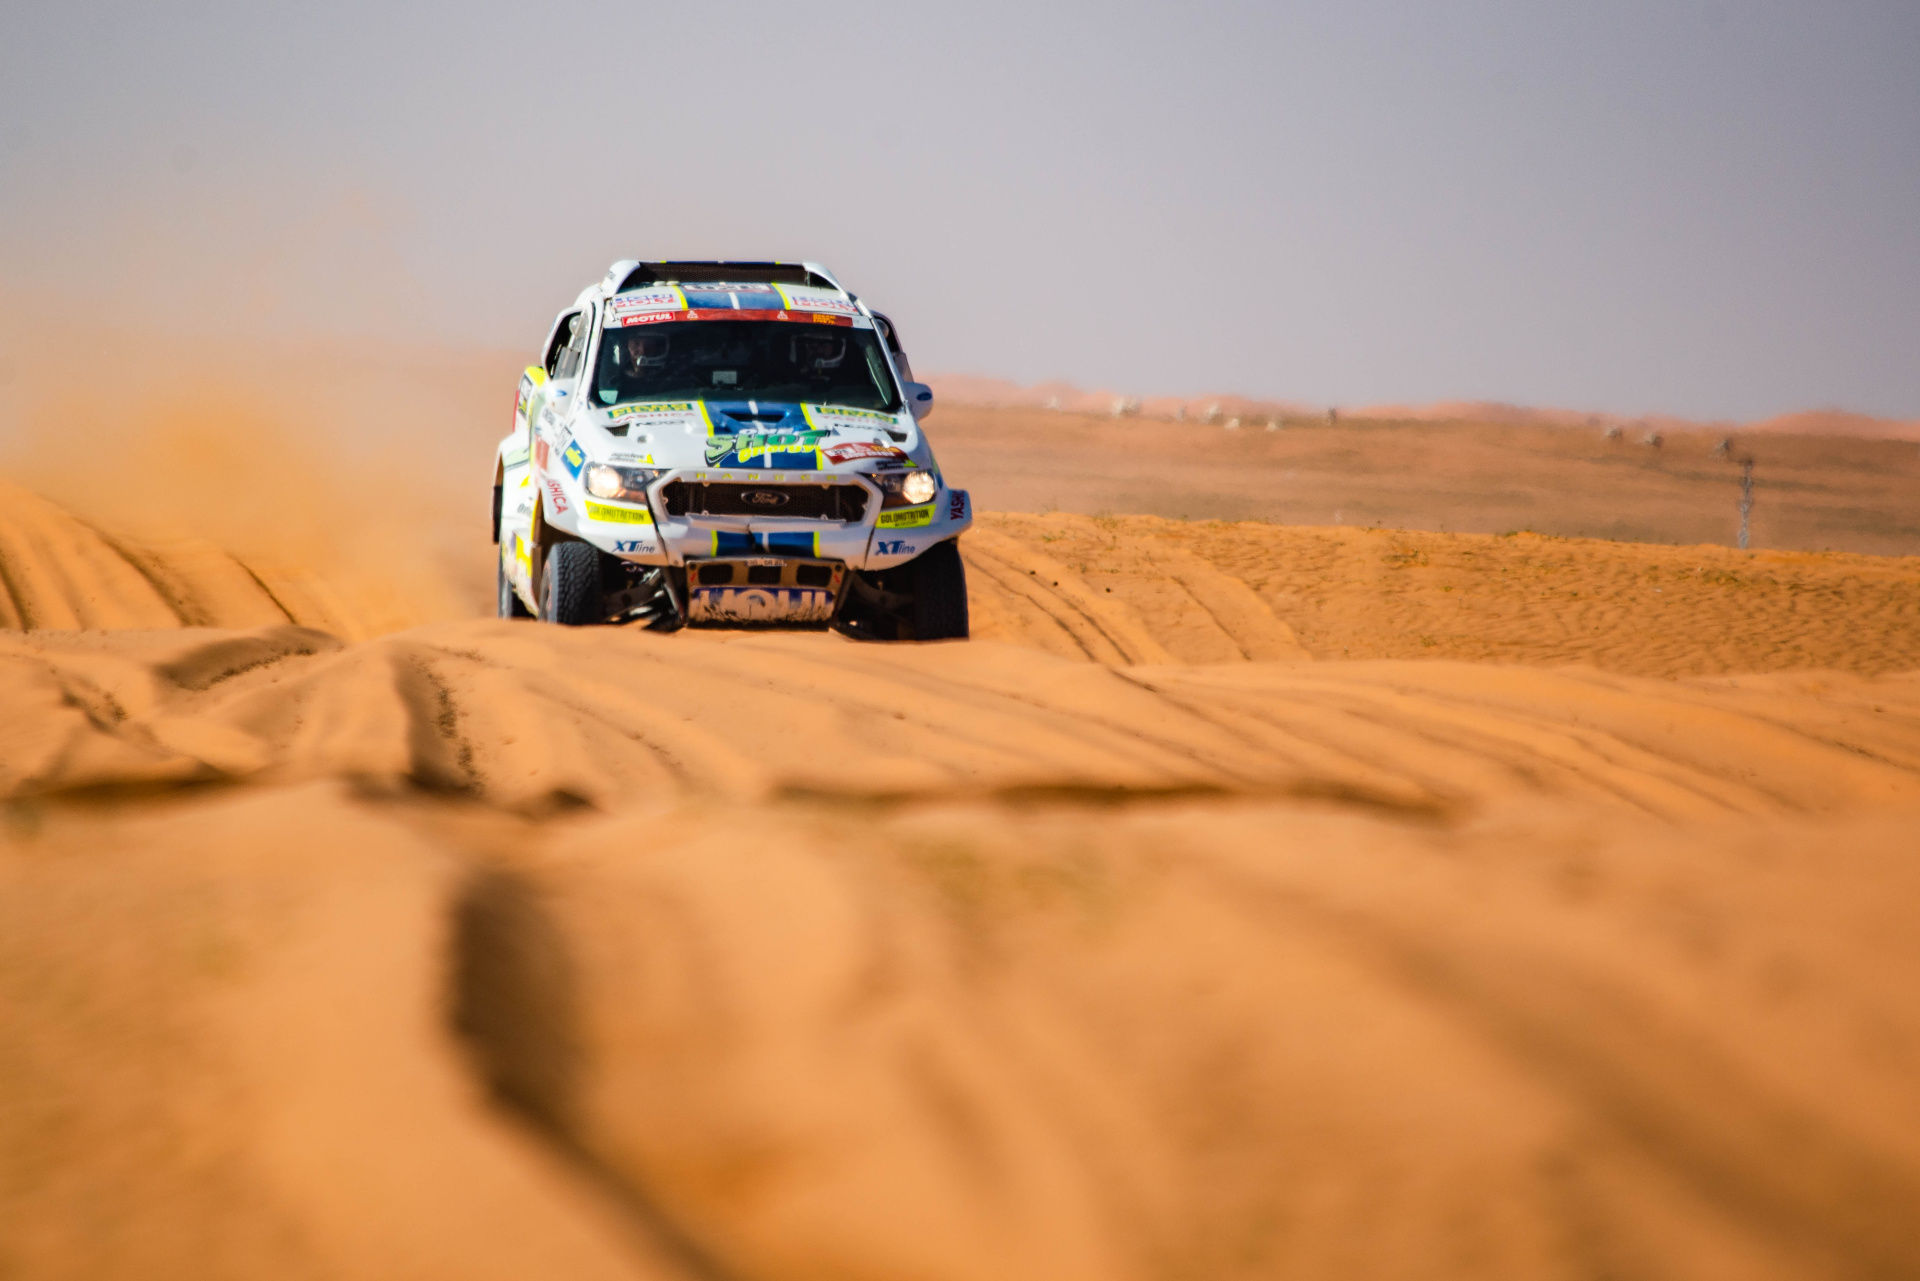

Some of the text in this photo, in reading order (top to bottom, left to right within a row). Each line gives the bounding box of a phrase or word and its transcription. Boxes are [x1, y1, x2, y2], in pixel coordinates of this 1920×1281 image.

[626, 311, 673, 324] MOTUL
[705, 430, 830, 465] SHOT
[752, 491, 780, 505] Ford
